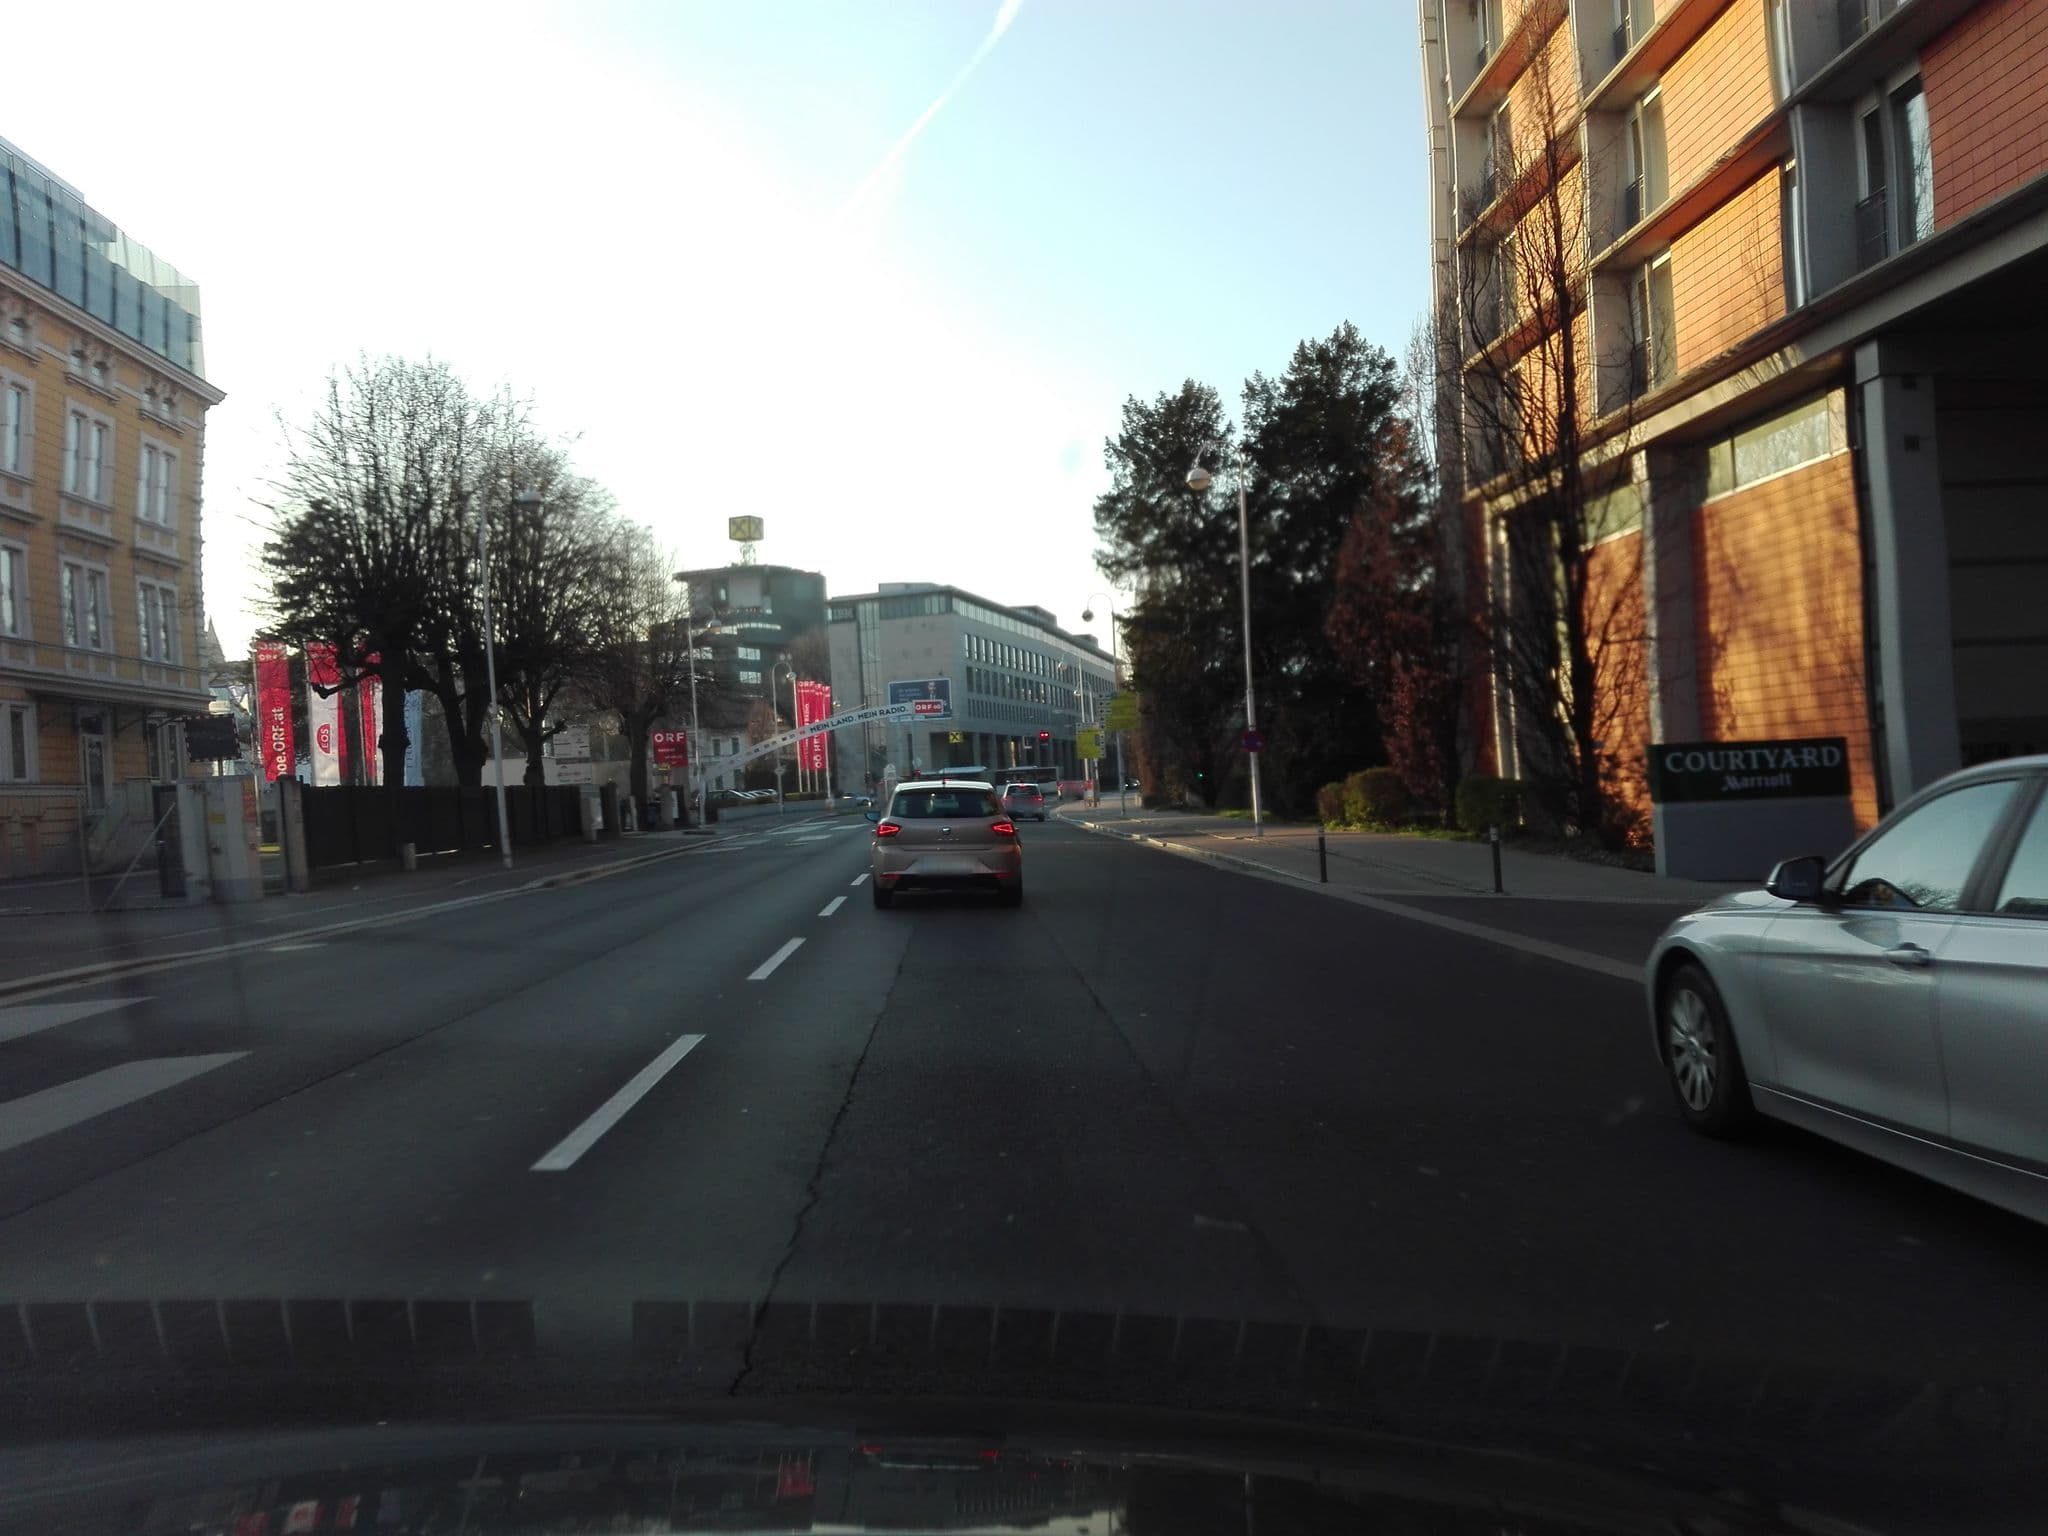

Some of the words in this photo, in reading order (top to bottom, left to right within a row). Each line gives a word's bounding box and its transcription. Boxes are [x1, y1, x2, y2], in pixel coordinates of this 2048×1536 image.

[809, 722, 830, 733] MEIN
[858, 710, 878, 720] MEIN
[654, 732, 685, 742] ORF
[1665, 746, 1841, 773] COURTYARD
[1721, 773, 1792, 792] Marriott
